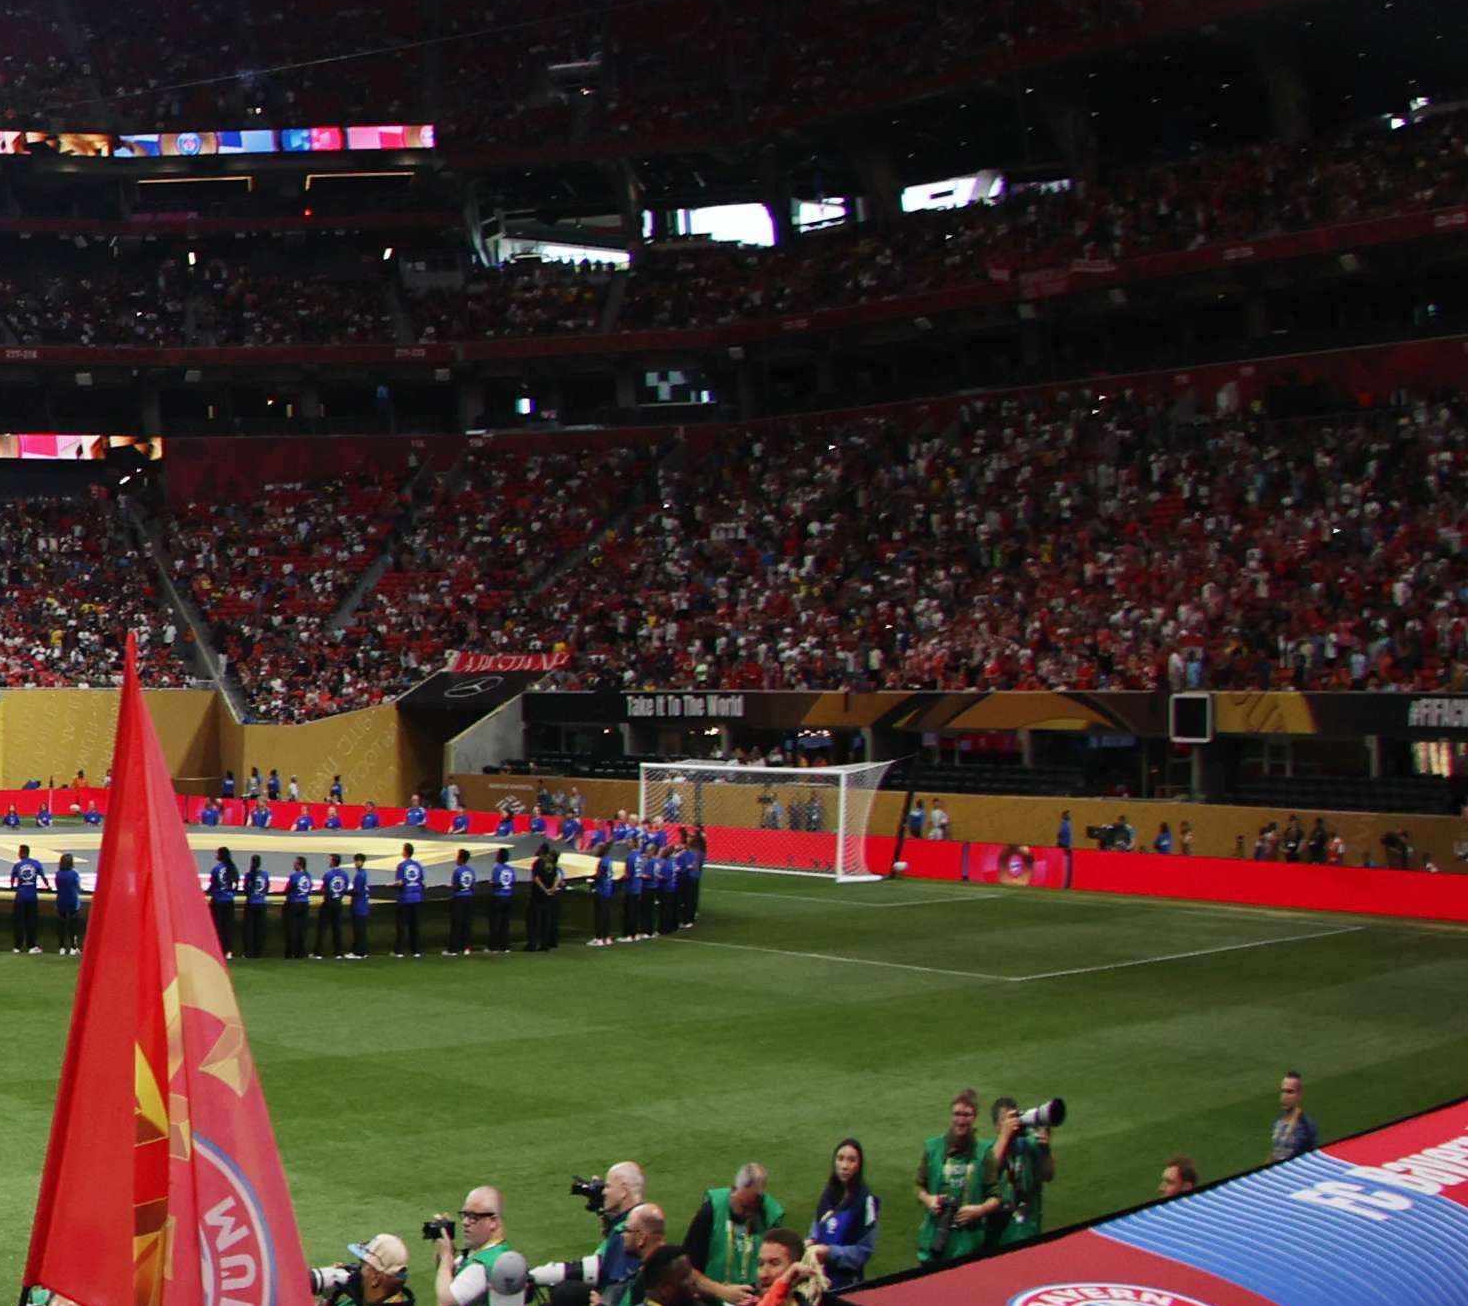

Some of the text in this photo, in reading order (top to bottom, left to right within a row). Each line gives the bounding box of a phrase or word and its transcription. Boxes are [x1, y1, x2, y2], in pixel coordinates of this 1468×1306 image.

[627, 695, 744, 717] Take It To The World
[1290, 1180, 1413, 1221] FC
